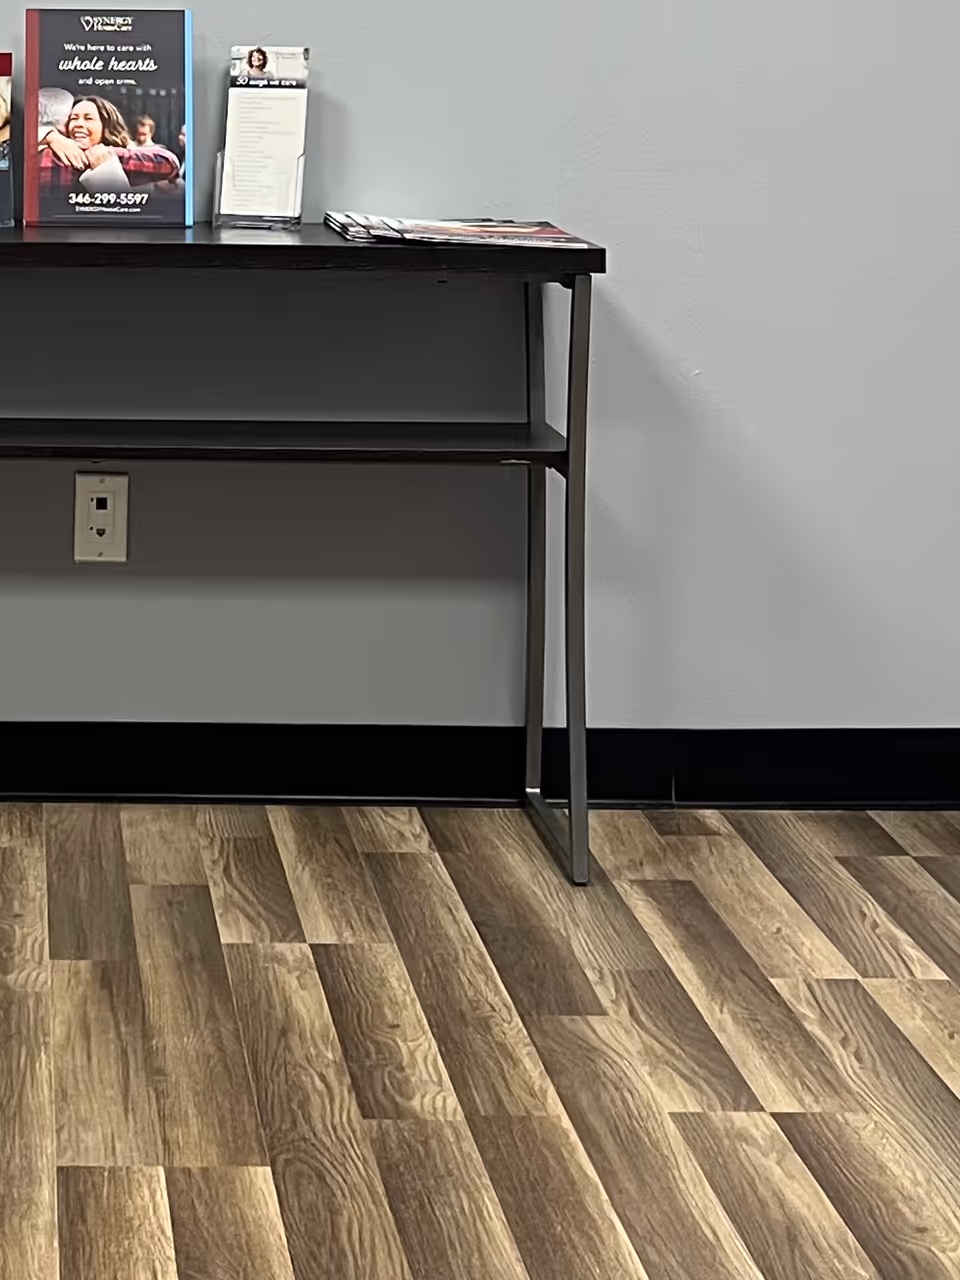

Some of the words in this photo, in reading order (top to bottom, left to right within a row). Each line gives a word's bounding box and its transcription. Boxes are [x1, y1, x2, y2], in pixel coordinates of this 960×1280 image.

[63, 43, 85, 51] We're
[87, 43, 104, 51] here
[58, 56, 104, 71] whole
[108, 56, 158, 71] hearts
[78, 77, 93, 85] and
[94, 78, 114, 86] open
[236, 76, 248, 85] 50
[68, 193, 149, 205] 346-299-5597
